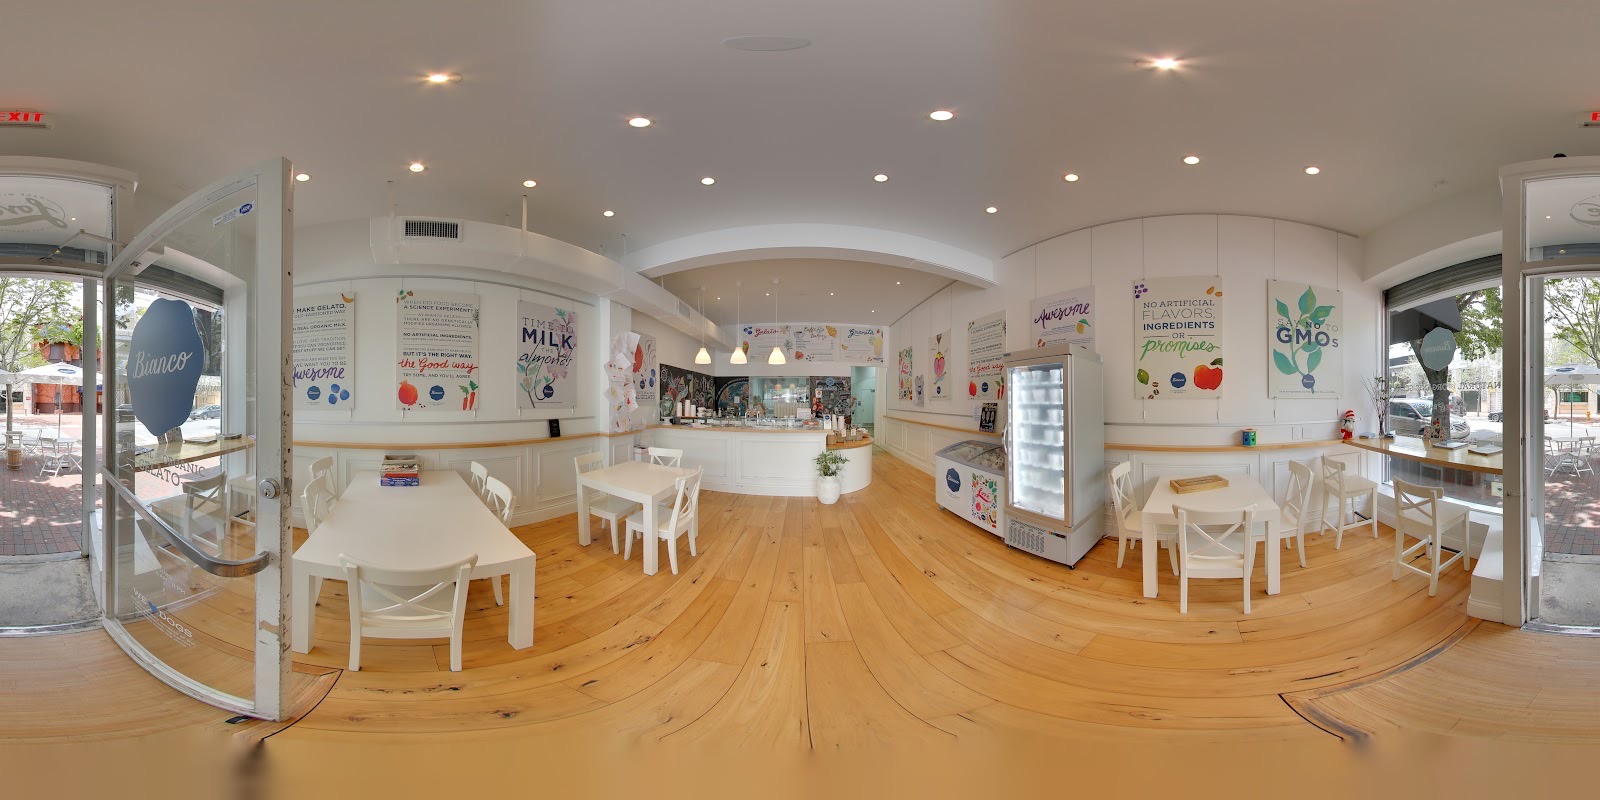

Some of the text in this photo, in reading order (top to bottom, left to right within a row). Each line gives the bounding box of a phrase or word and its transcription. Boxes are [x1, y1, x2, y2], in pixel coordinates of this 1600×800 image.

[522, 317, 554, 331] TIME
[1034, 303, 1090, 329] Awesome
[1143, 308, 1216, 320] FLAVORS,
[1143, 321, 1215, 331] INGREDIENTS
[1278, 319, 1339, 332] SAY NO TO
[522, 327, 574, 349] MILK
[1140, 337, 1220, 361] promises
[133, 350, 193, 380] Bianco
[398, 358, 479, 374] the Good way
[293, 367, 345, 388] Awesome
[140, 458, 180, 486] GELATO
[159, 610, 193, 638] DOGS
